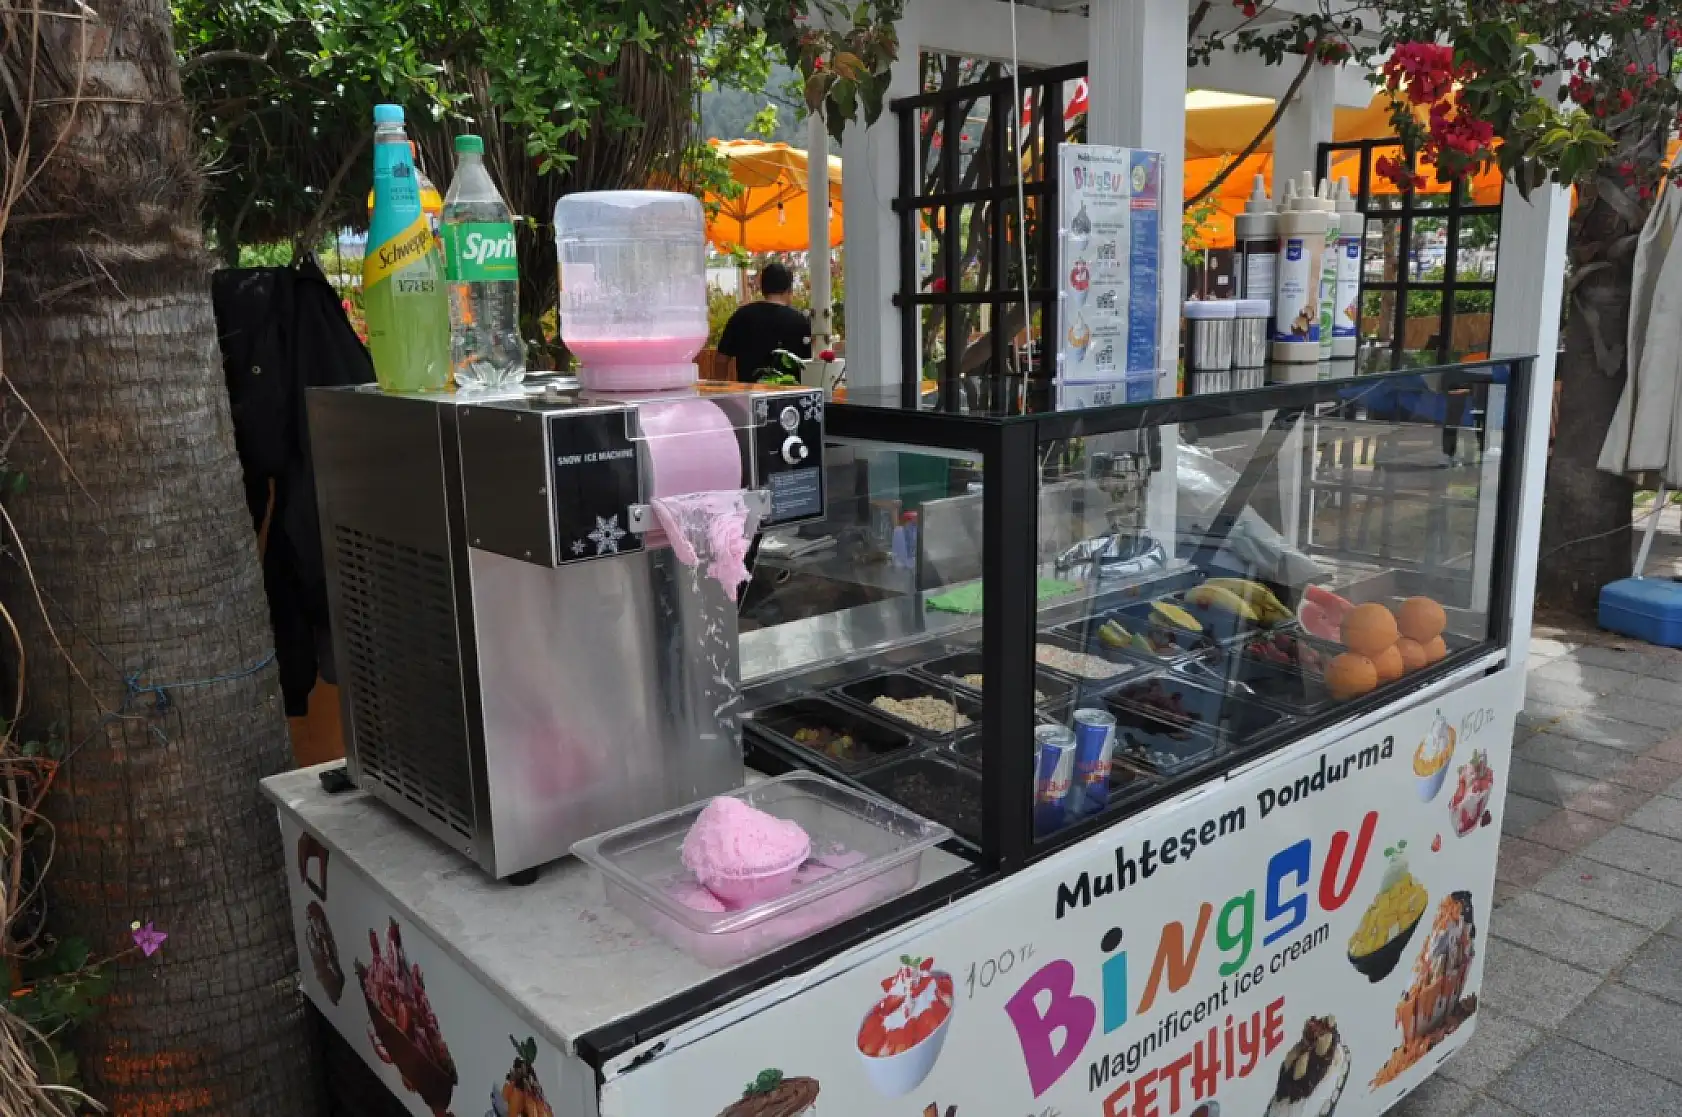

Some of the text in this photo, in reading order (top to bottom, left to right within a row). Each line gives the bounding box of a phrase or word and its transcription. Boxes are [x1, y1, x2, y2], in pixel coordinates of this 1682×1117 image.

[557, 447, 635, 467] SNOW ICE MACHINE
[1056, 735, 1394, 919] Muhteşem Dondurma
[963, 948, 1015, 1000] 100
[1088, 922, 1330, 1092] Magnificent ice cream
